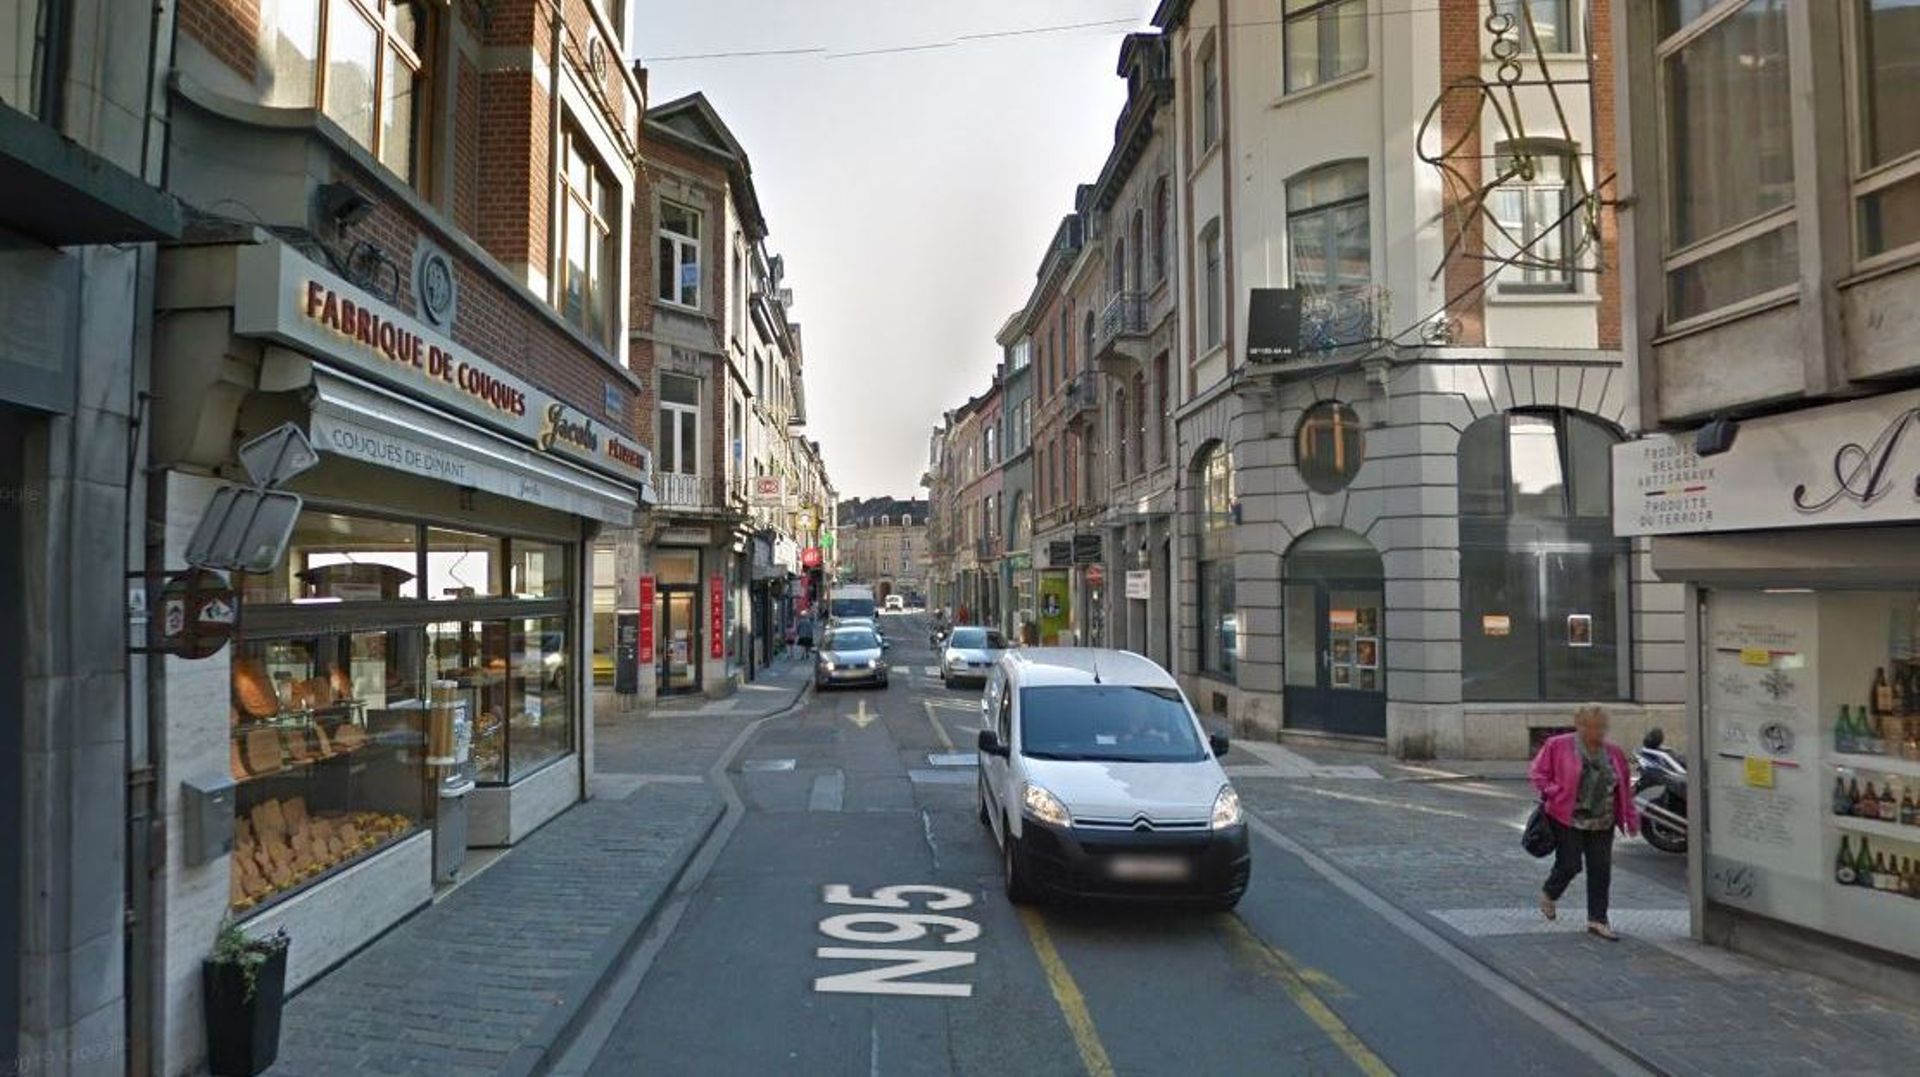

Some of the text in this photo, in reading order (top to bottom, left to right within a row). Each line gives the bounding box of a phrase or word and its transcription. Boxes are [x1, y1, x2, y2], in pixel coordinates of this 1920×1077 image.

[307, 280, 526, 416] FABRIQUE DE COUQUES
[332, 428, 467, 480] COUQUES DE DINANT
[814, 884, 981, 997] N95
